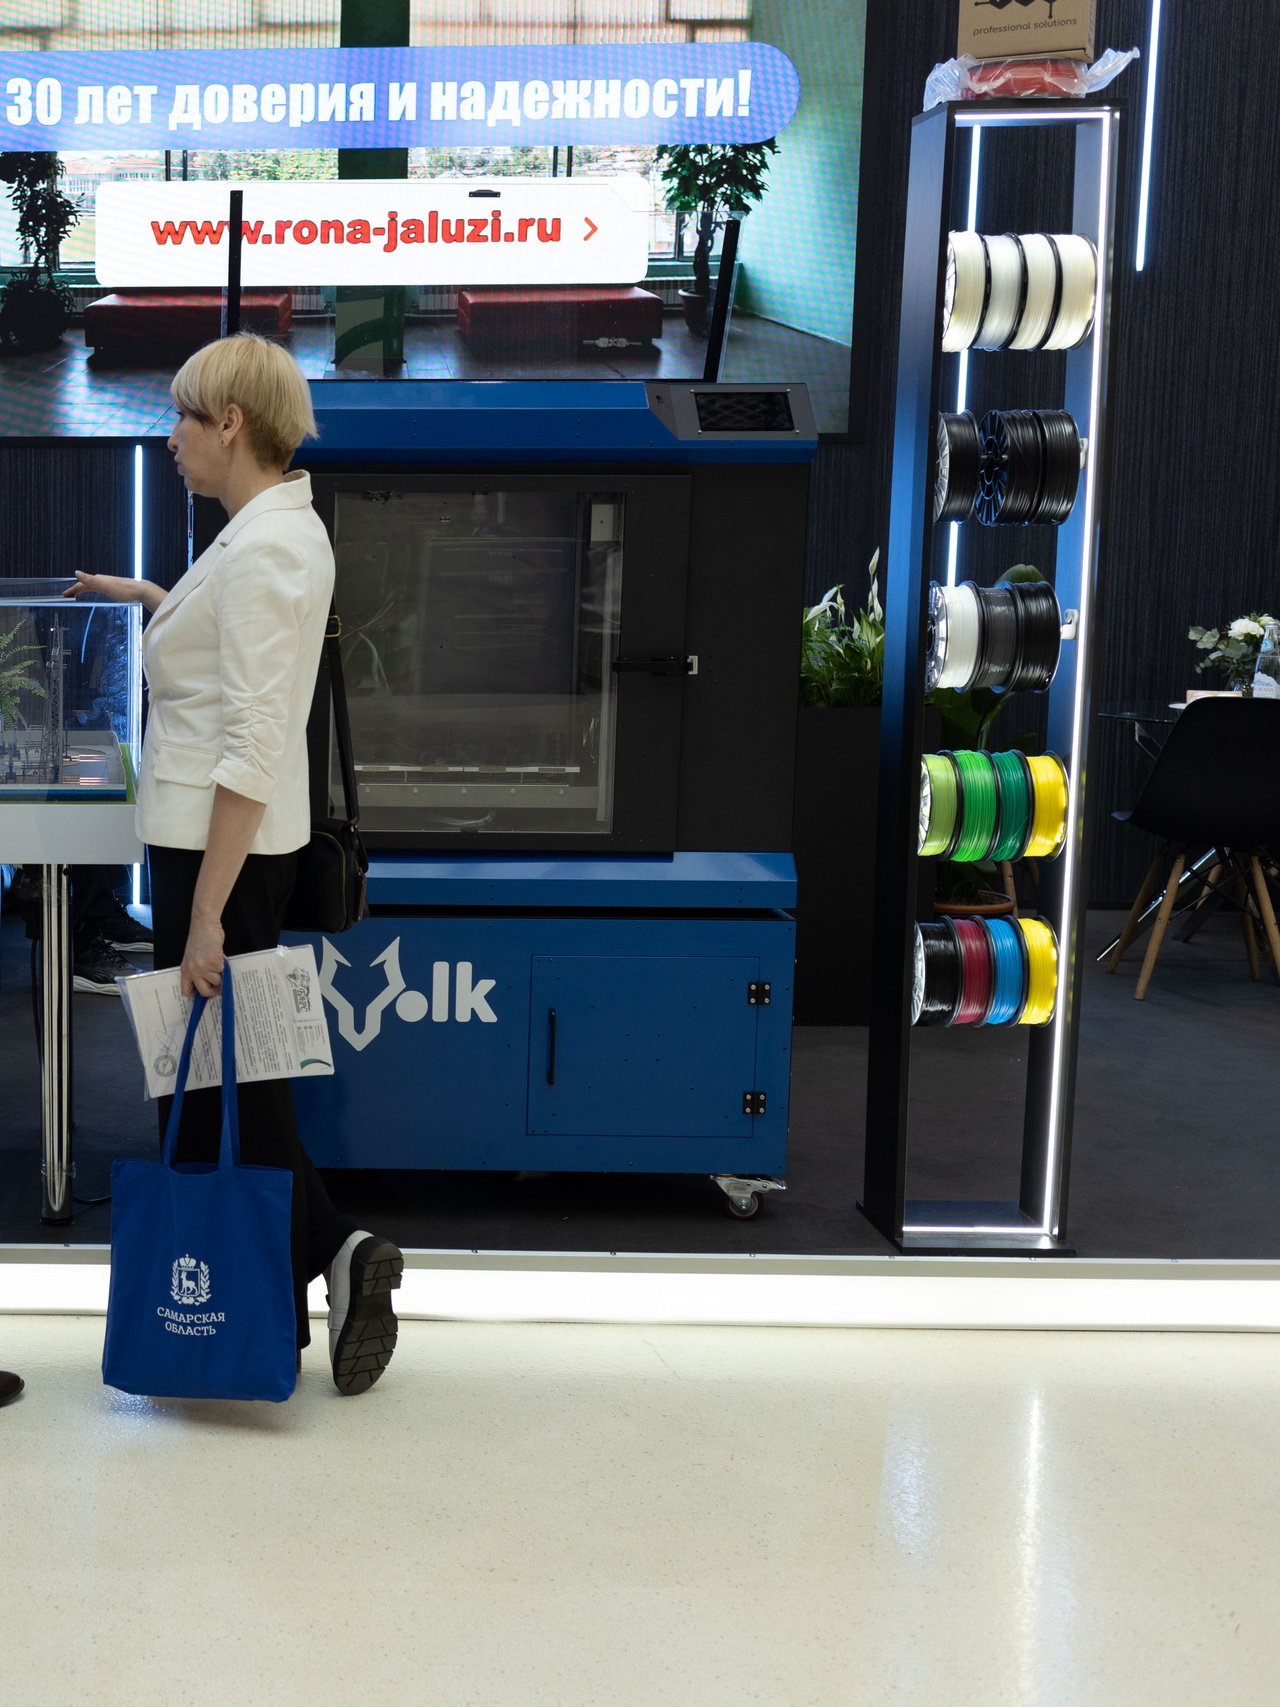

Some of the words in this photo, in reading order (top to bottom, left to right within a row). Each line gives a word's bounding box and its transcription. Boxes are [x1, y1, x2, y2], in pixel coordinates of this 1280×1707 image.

[973, 21, 1031, 37] professional
[1033, 18, 1077, 29] solutions
[6, 77, 62, 126] 30
[74, 85, 158, 125] лет
[168, 82, 376, 131] доверия
[388, 82, 417, 121] и
[430, 69, 752, 127] надежности!
[157, 1306, 226, 1324] САМАРСКАЯ
[165, 1321, 217, 1336] ОБЛАСТЬ
